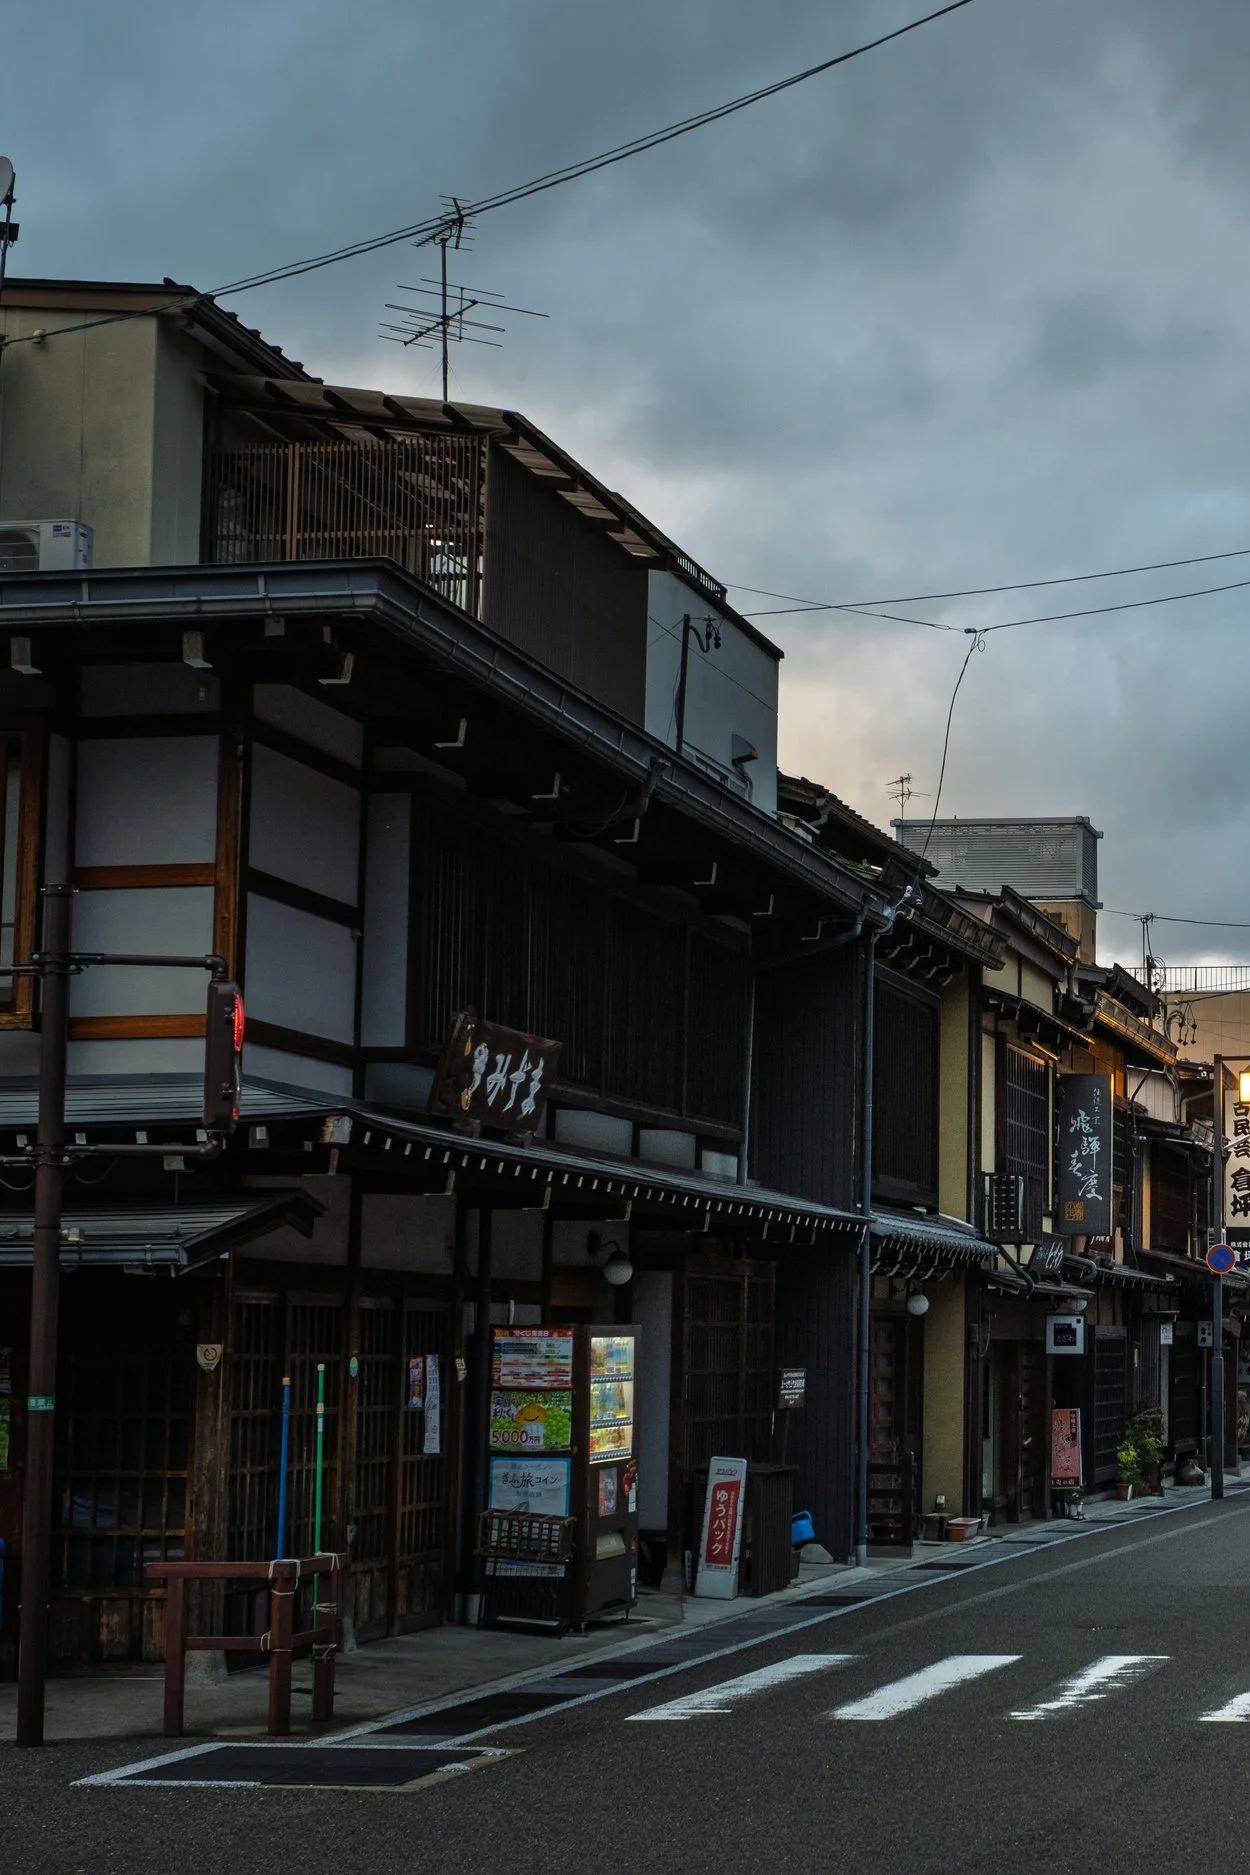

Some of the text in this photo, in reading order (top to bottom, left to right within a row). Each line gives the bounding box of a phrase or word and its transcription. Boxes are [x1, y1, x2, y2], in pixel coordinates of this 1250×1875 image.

[502, 1472, 558, 1489] ぎふ旅コイン
[712, 1490, 730, 1556] ゆうパック
